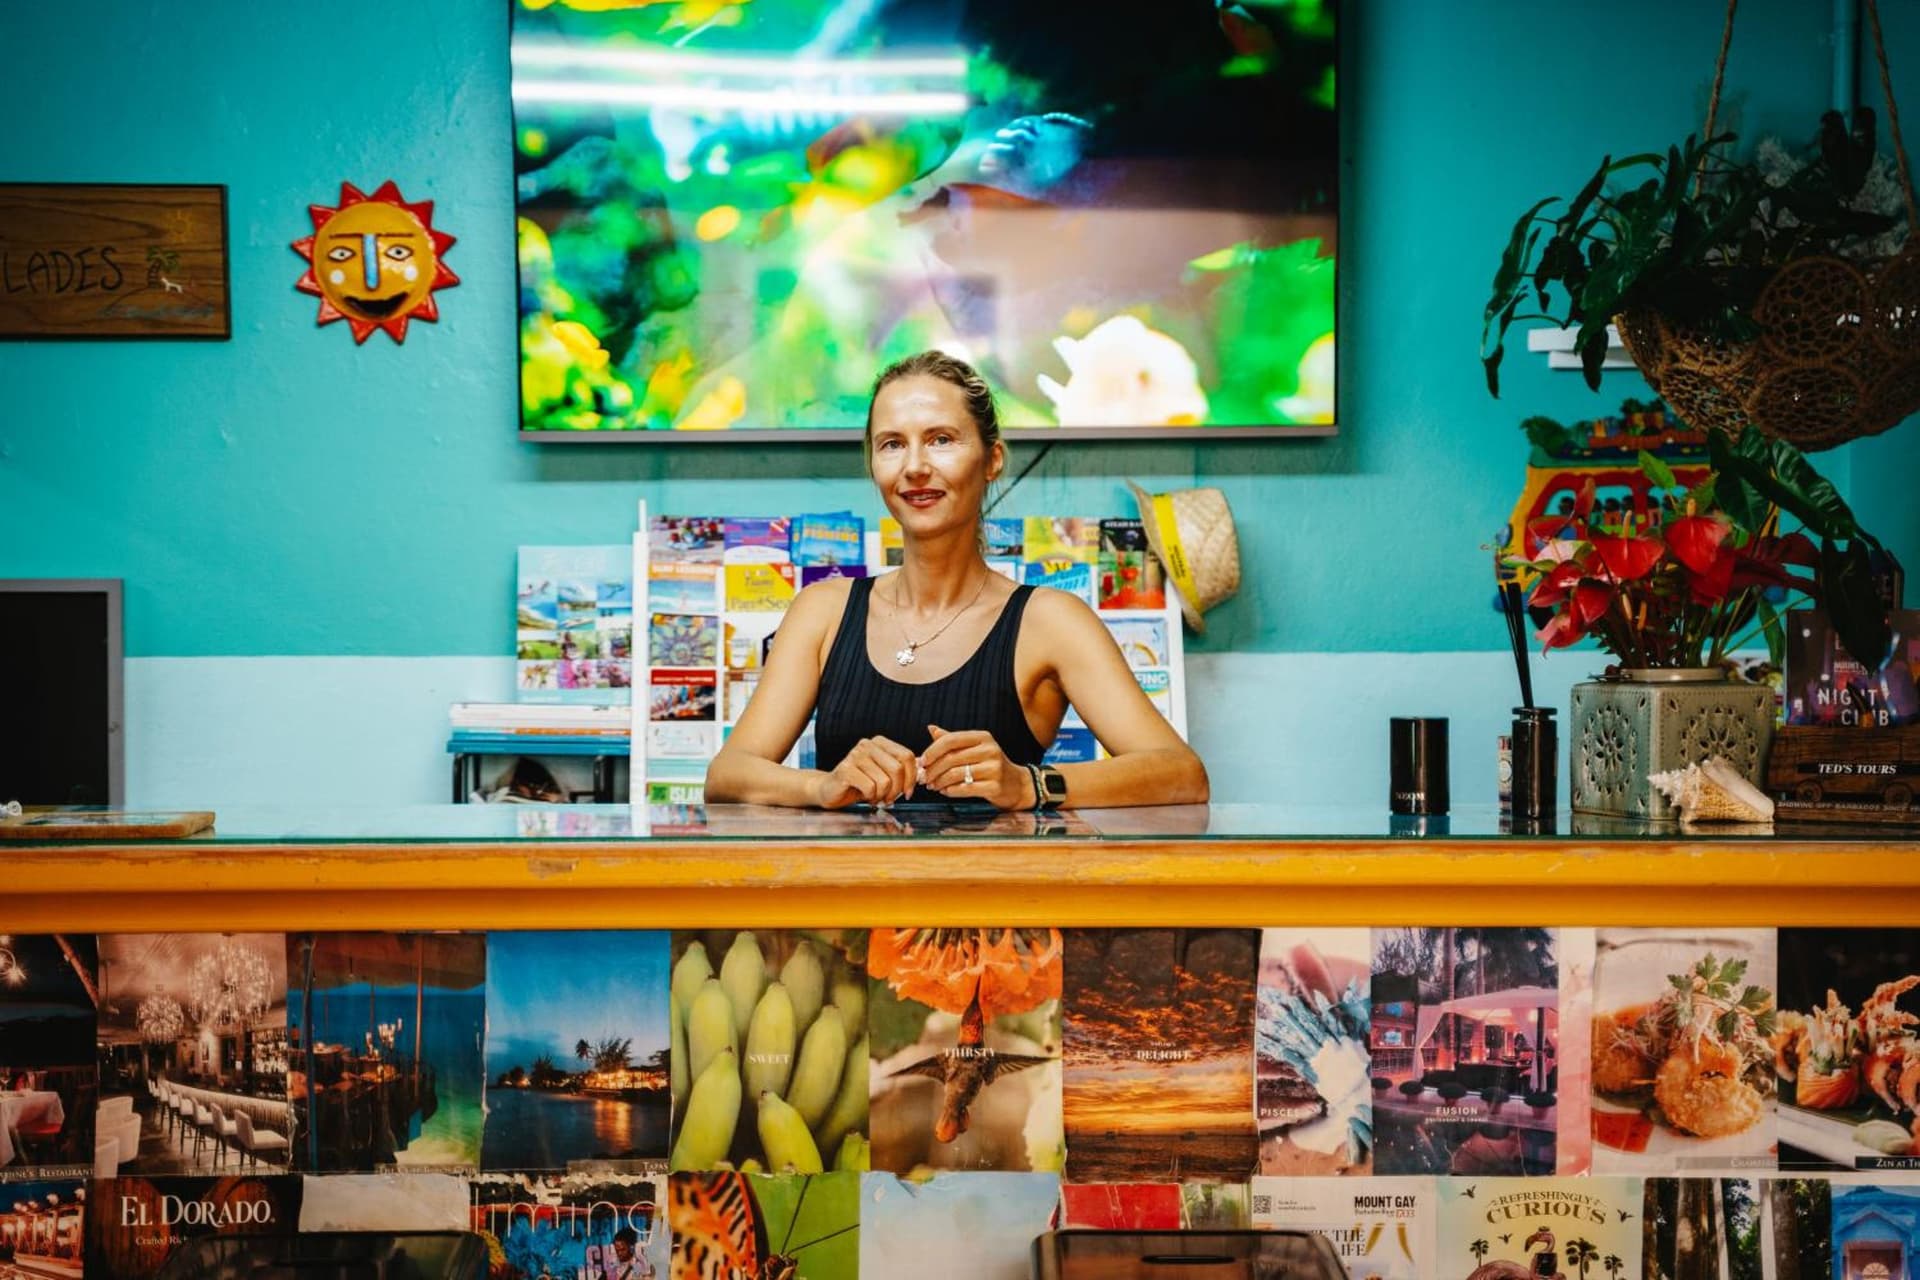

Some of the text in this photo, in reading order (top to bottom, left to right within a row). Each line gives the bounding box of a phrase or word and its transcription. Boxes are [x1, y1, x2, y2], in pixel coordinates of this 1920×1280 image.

[2, 246, 123, 293] LADES
[1818, 688, 1878, 706] NIGT
[1841, 709, 1889, 726] CLB
[1818, 763, 1897, 775] TED'S TOURS
[749, 1054, 790, 1065] SWEET
[942, 1047, 995, 1058] THIRSTY
[1136, 1050, 1192, 1060] DELIGHT
[1435, 1106, 1478, 1116] FUSION
[1354, 1195, 1416, 1208] MOUNT GAY
[1498, 1190, 1592, 1206] REFRESHINGLY
[121, 1194, 271, 1228] EL DORADO
[1486, 1201, 1607, 1225] CURIOUS
